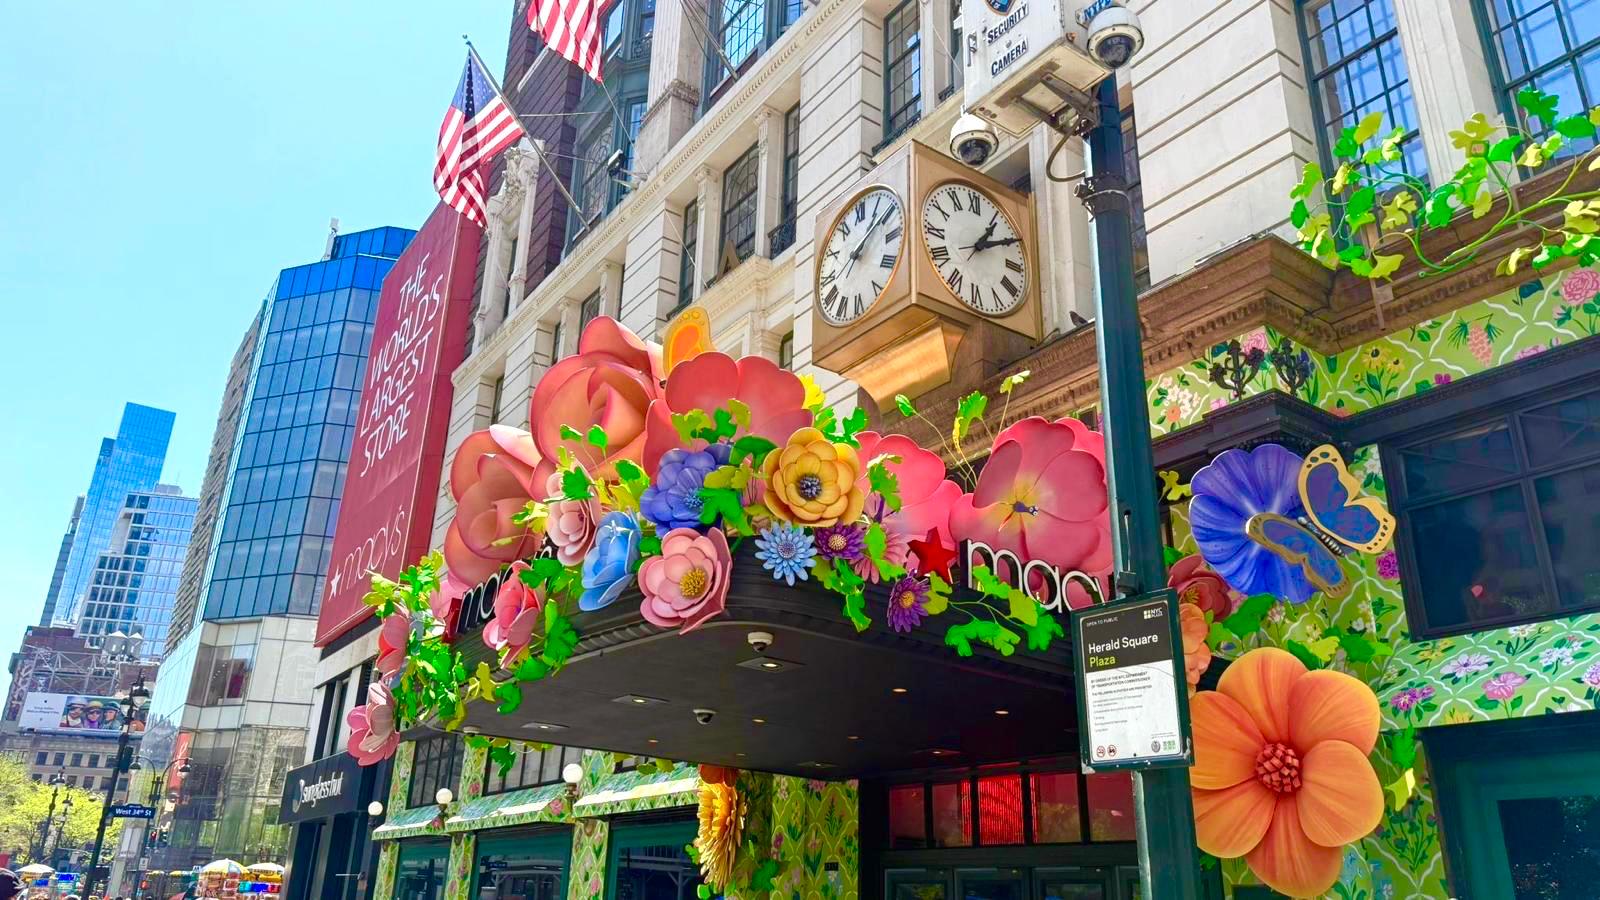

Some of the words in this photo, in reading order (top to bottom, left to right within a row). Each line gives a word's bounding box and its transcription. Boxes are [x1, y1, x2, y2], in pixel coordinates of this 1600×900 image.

[987, 3, 1027, 44] SECURITY
[991, 40, 1027, 76] CAMERA
[398, 252, 430, 321] THE
[370, 273, 443, 389] WORLD'S
[360, 326, 434, 438] LARGEST
[360, 391, 415, 478] STORE
[1088, 638, 1120, 654] Herald
[1121, 634, 1158, 649] Square
[1089, 655, 1115, 667] Plaza
